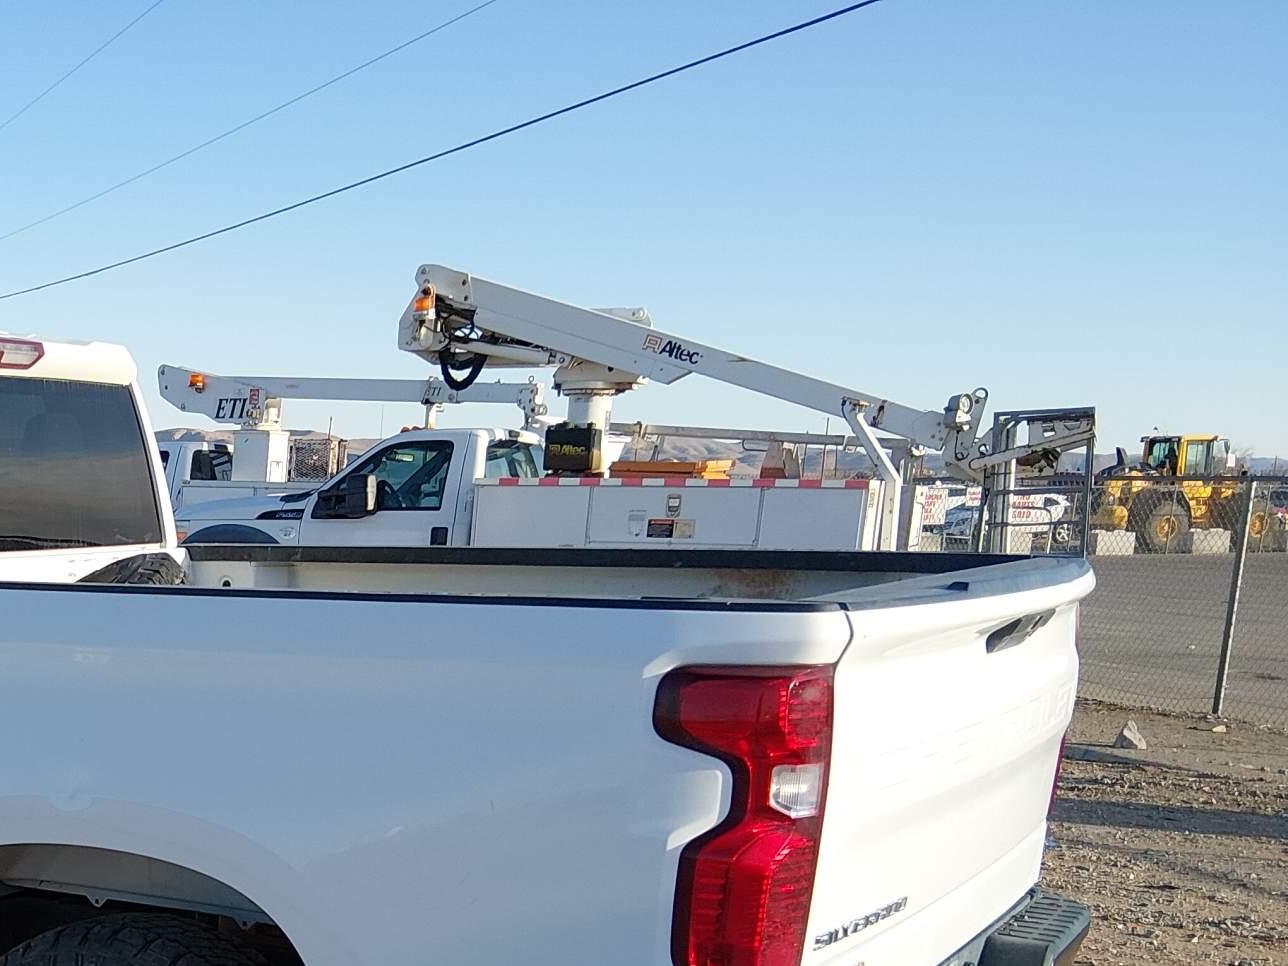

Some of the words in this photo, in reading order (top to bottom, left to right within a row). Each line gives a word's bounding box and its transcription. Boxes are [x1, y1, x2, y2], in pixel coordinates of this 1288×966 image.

[659, 340, 700, 365] Altec
[215, 398, 248, 419] ETI
[561, 444, 586, 457] Altec
[813, 896, 908, 952] SILVERADO
